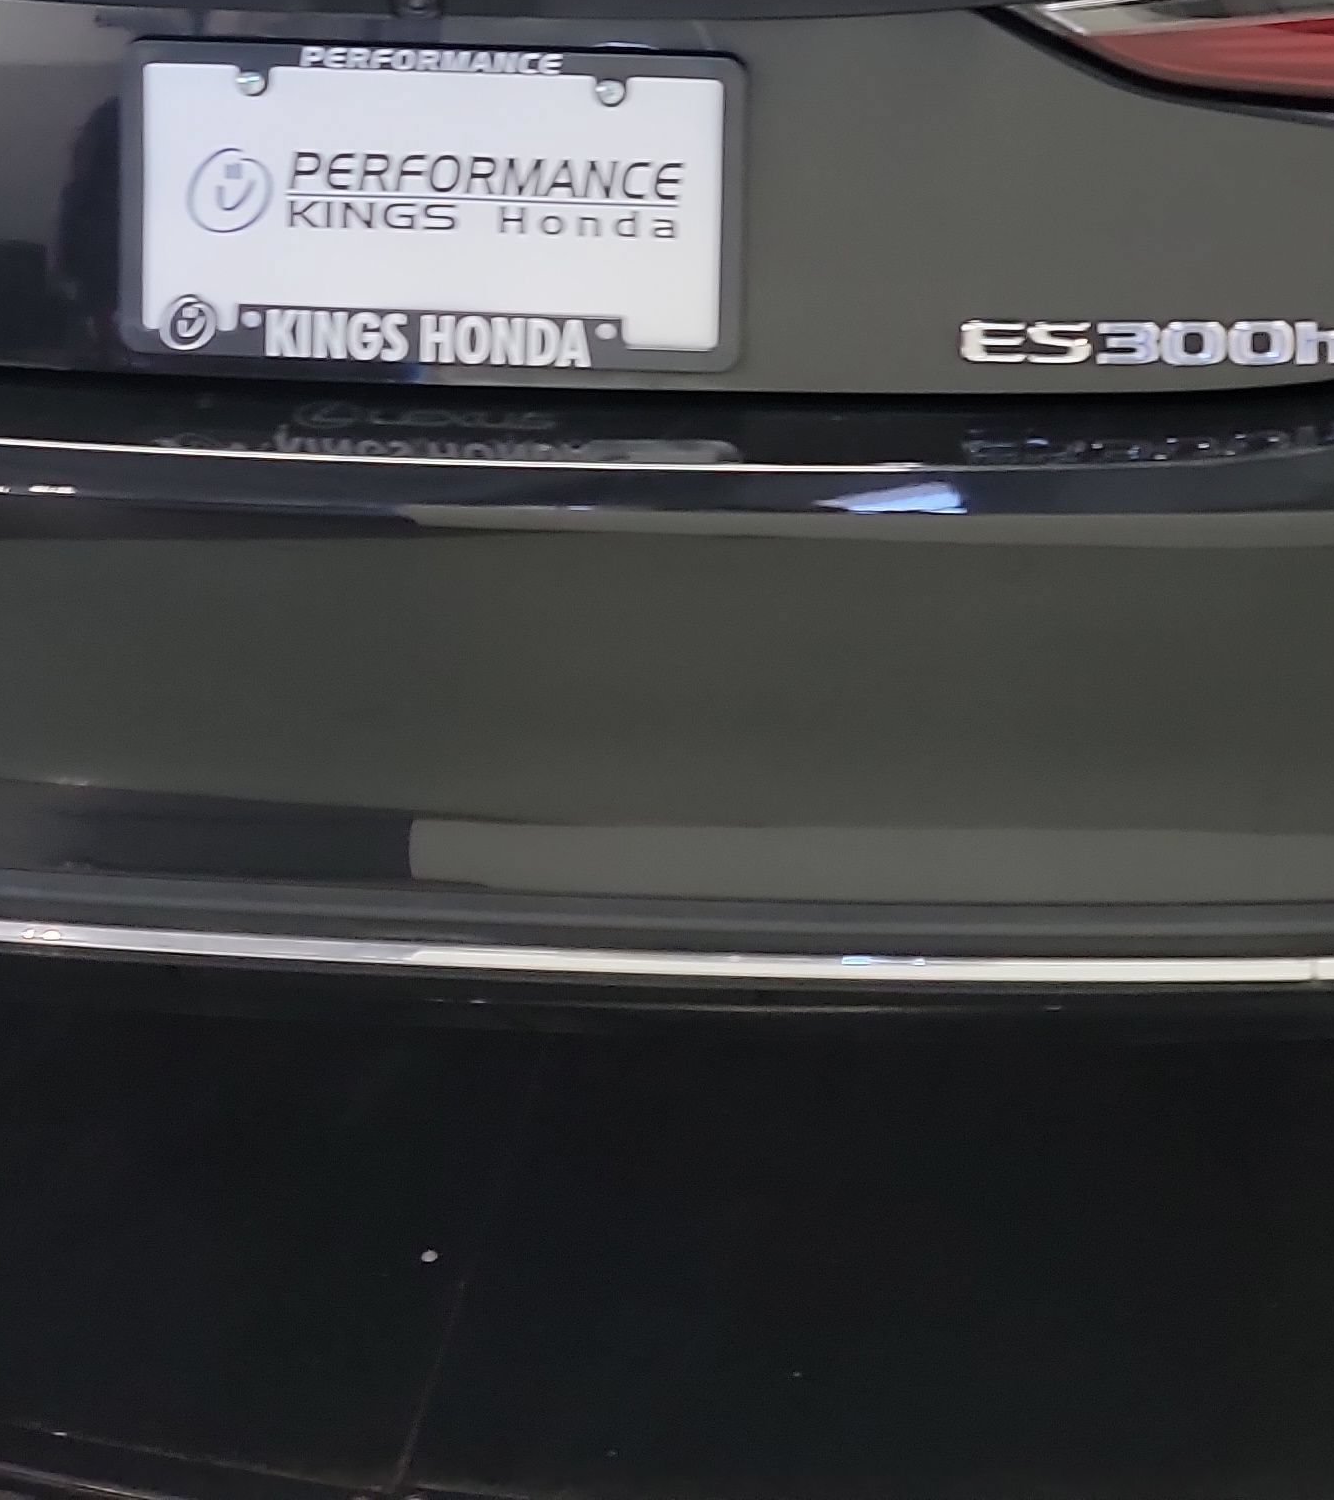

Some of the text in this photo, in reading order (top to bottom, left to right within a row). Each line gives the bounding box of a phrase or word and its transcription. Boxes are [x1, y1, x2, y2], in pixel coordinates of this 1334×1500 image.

[299, 46, 564, 75] PERFORMANCE
[289, 151, 684, 200] PERFORMANCE
[287, 200, 679, 239] KINGS Honda
[265, 309, 592, 368] KINGS HONDA
